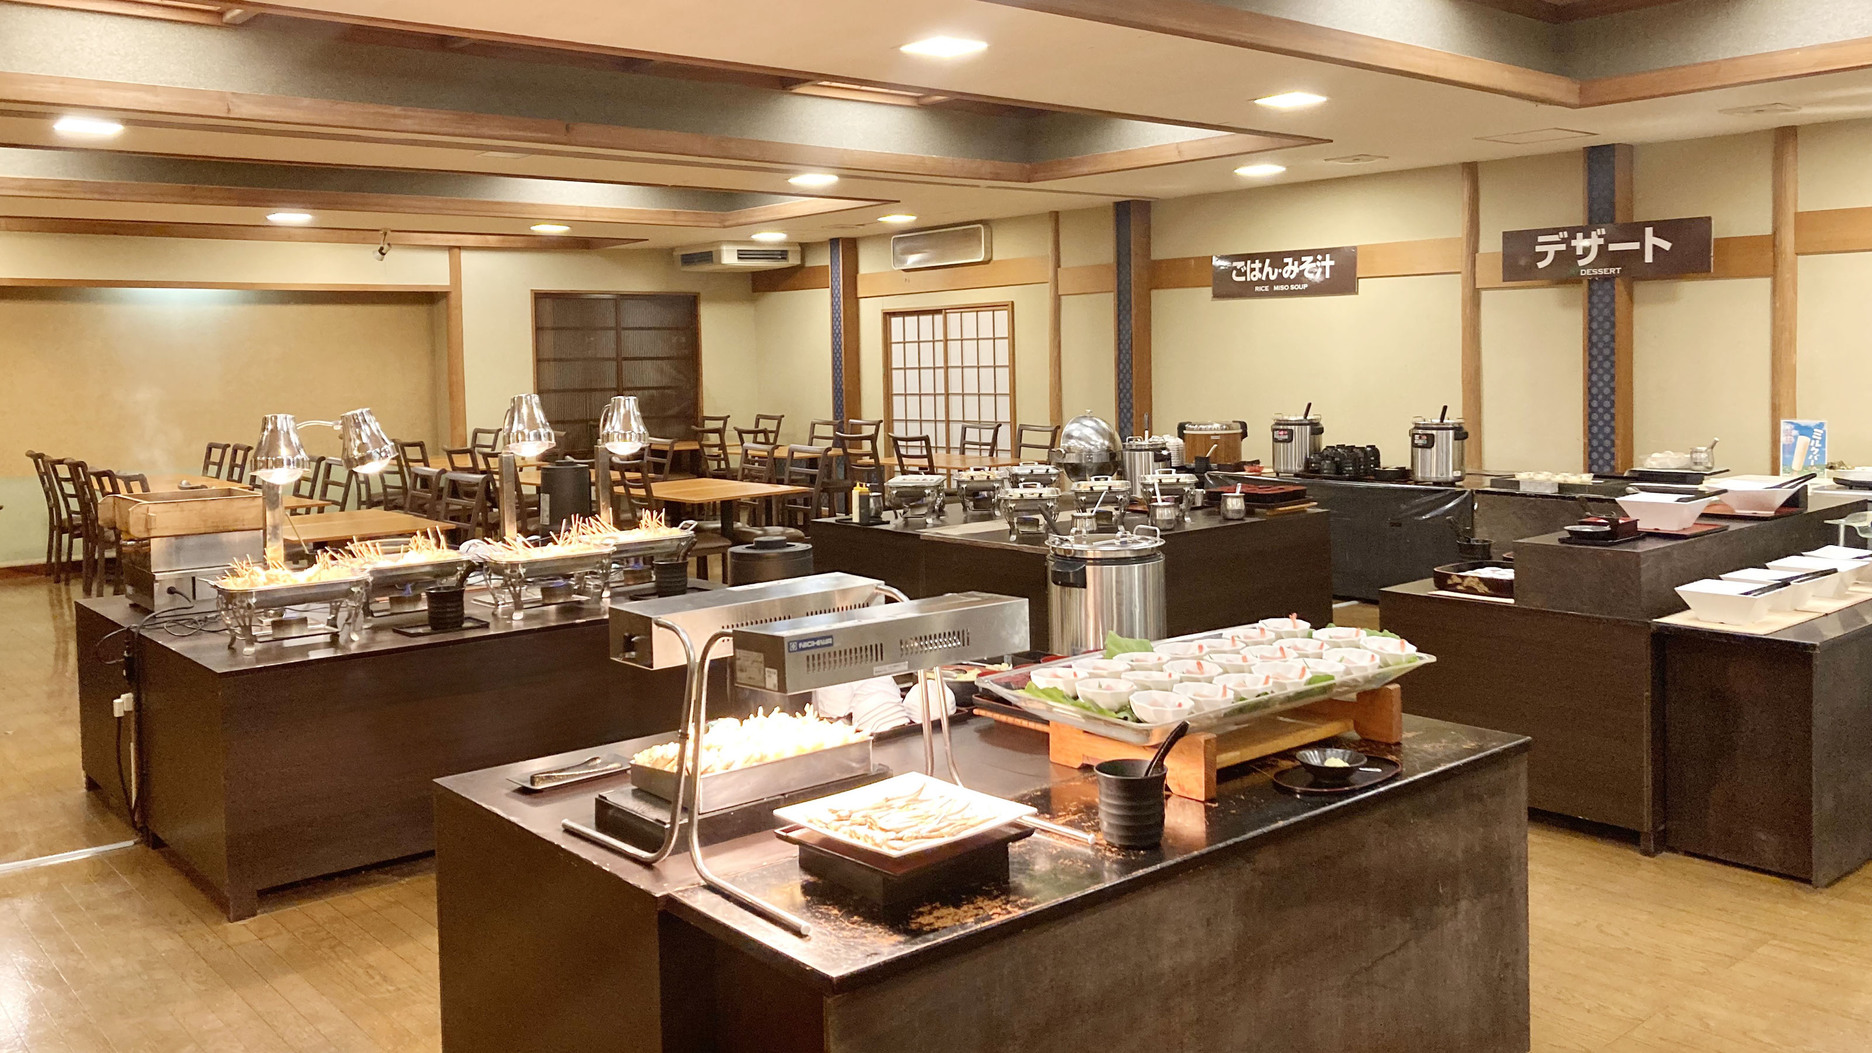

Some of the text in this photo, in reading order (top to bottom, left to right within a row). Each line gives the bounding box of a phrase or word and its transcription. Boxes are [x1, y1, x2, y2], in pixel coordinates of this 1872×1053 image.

[1535, 226, 1673, 269] デザート
[1580, 267, 1622, 276] DESSERT
[1290, 283, 1309, 291] SOUP
[1808, 428, 1824, 466] ミルクバー
